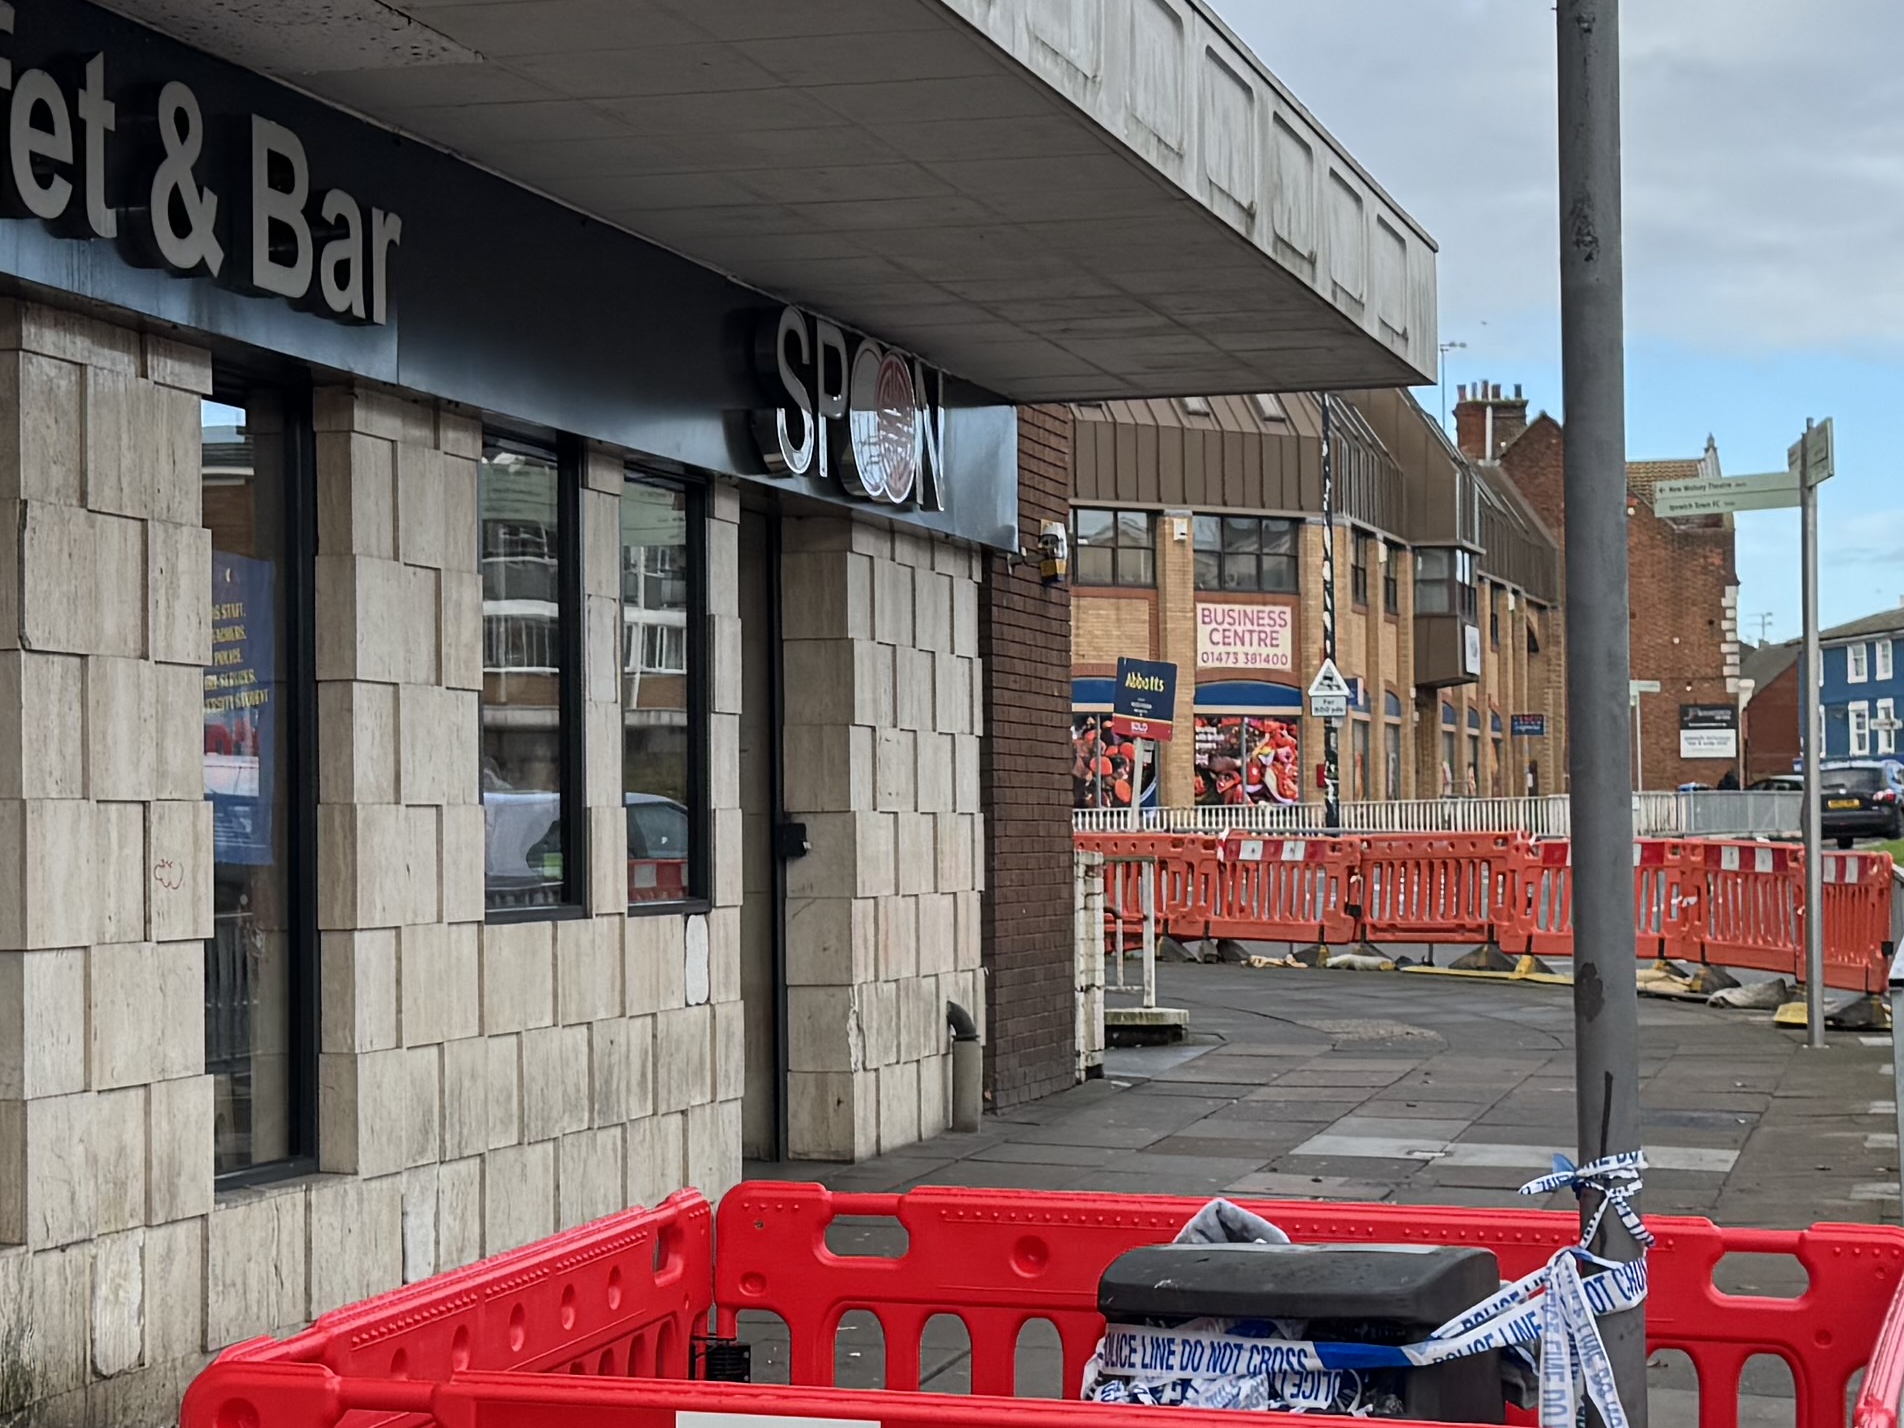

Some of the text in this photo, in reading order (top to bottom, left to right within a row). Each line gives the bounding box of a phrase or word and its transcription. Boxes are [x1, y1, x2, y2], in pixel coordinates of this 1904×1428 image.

[150, 80, 225, 281] &
[251, 113, 403, 328] Bar
[776, 304, 945, 513] SPOON
[1694, 500, 1711, 510] Town
[1712, 500, 1721, 508] FC
[1200, 607, 1288, 629] BUSINESS
[1208, 628, 1280, 649] CENTRE
[1201, 651, 1239, 665] 01473
[1584, 1276, 1616, 1314] OT
[1103, 1333, 1309, 1377] OLICE LINE DO NOT CROSS
